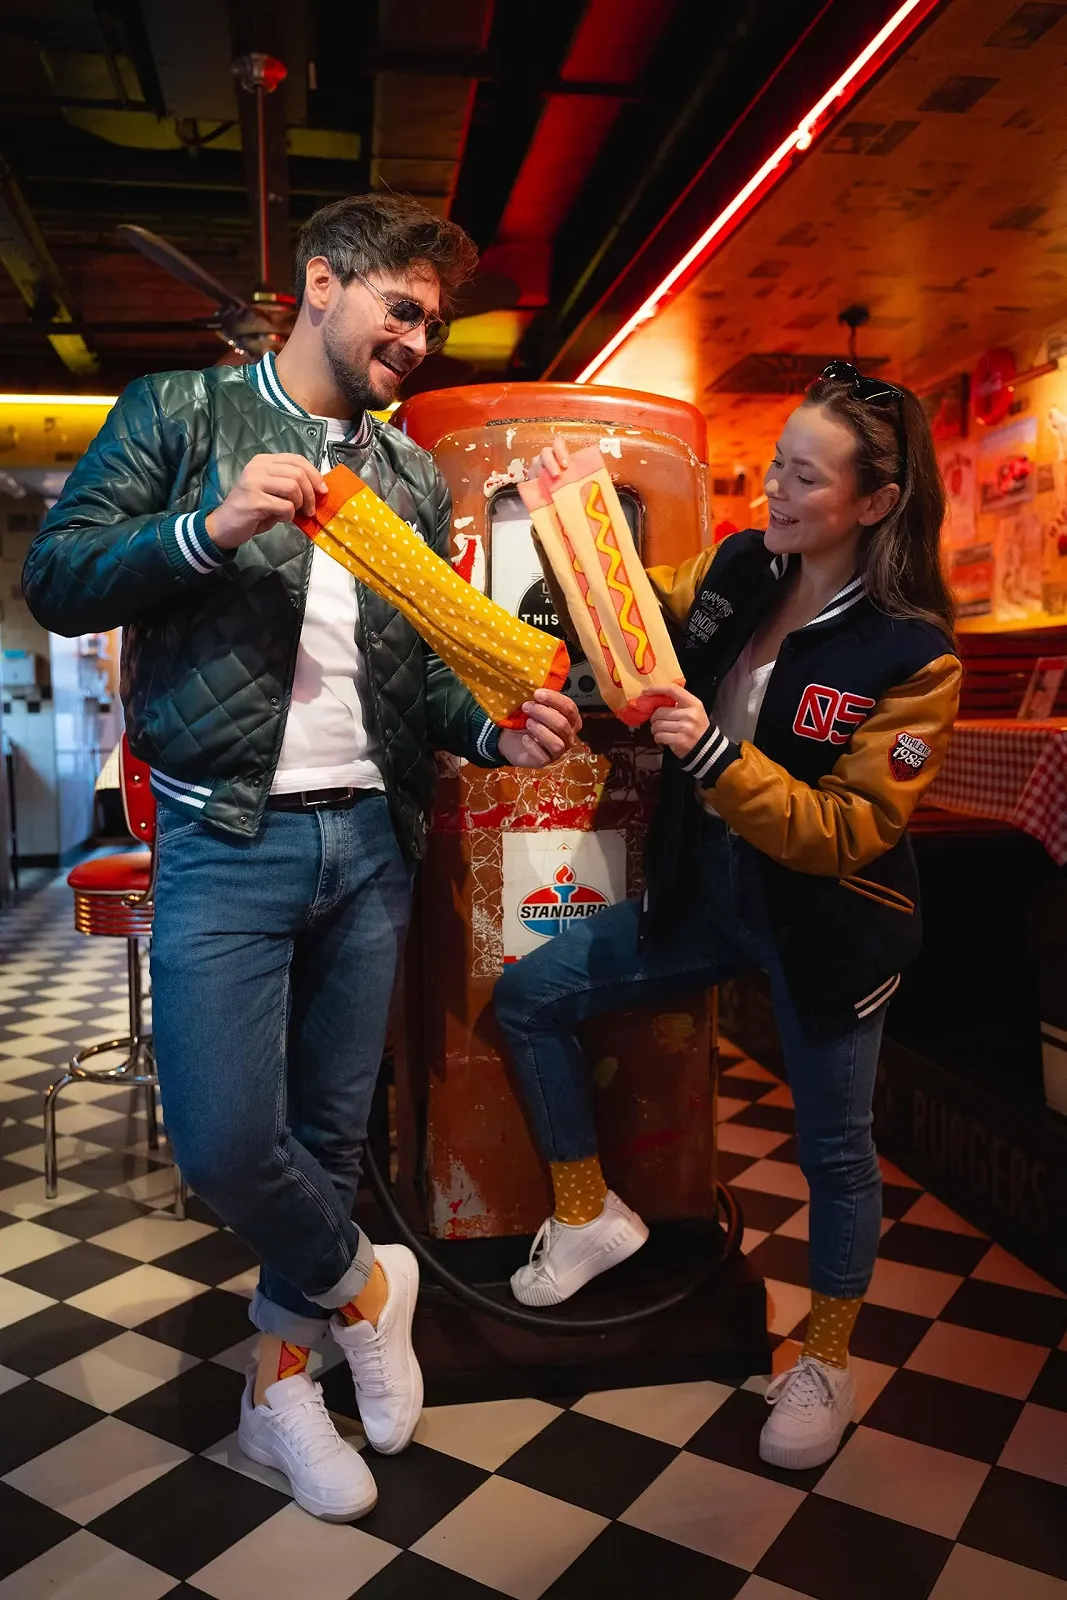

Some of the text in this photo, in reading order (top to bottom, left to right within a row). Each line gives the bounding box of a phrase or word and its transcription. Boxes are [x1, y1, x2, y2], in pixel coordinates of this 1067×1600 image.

[521, 614, 559, 626] THIS
[892, 746, 925, 768] 1985
[912, 1087, 1049, 1237] BURGERS
